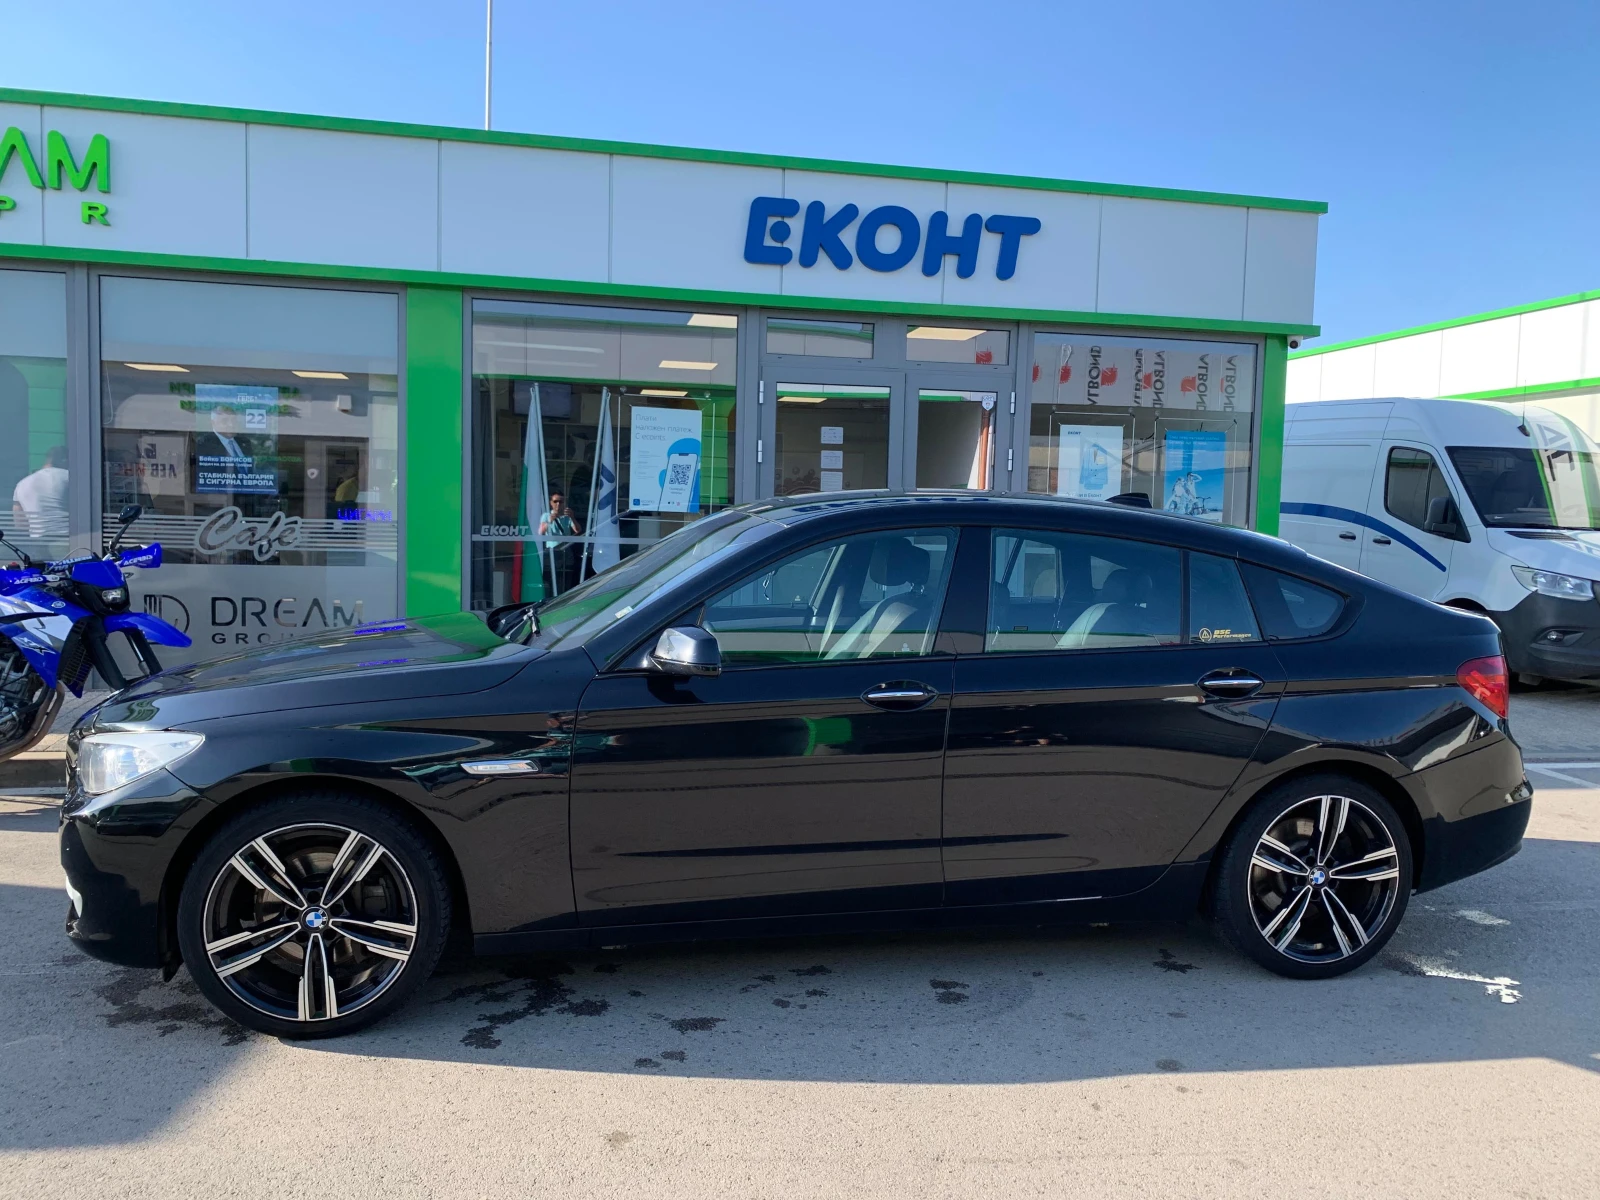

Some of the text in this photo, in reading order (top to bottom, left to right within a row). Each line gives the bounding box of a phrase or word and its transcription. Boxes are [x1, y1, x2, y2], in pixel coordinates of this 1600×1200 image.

[744, 196, 1042, 281] ЕКОНТ
[246, 412, 266, 425] 22
[337, 508, 393, 522] ЦИГАРИ
[481, 525, 529, 537] ЕКОНТ
[211, 596, 364, 628] DREAM
